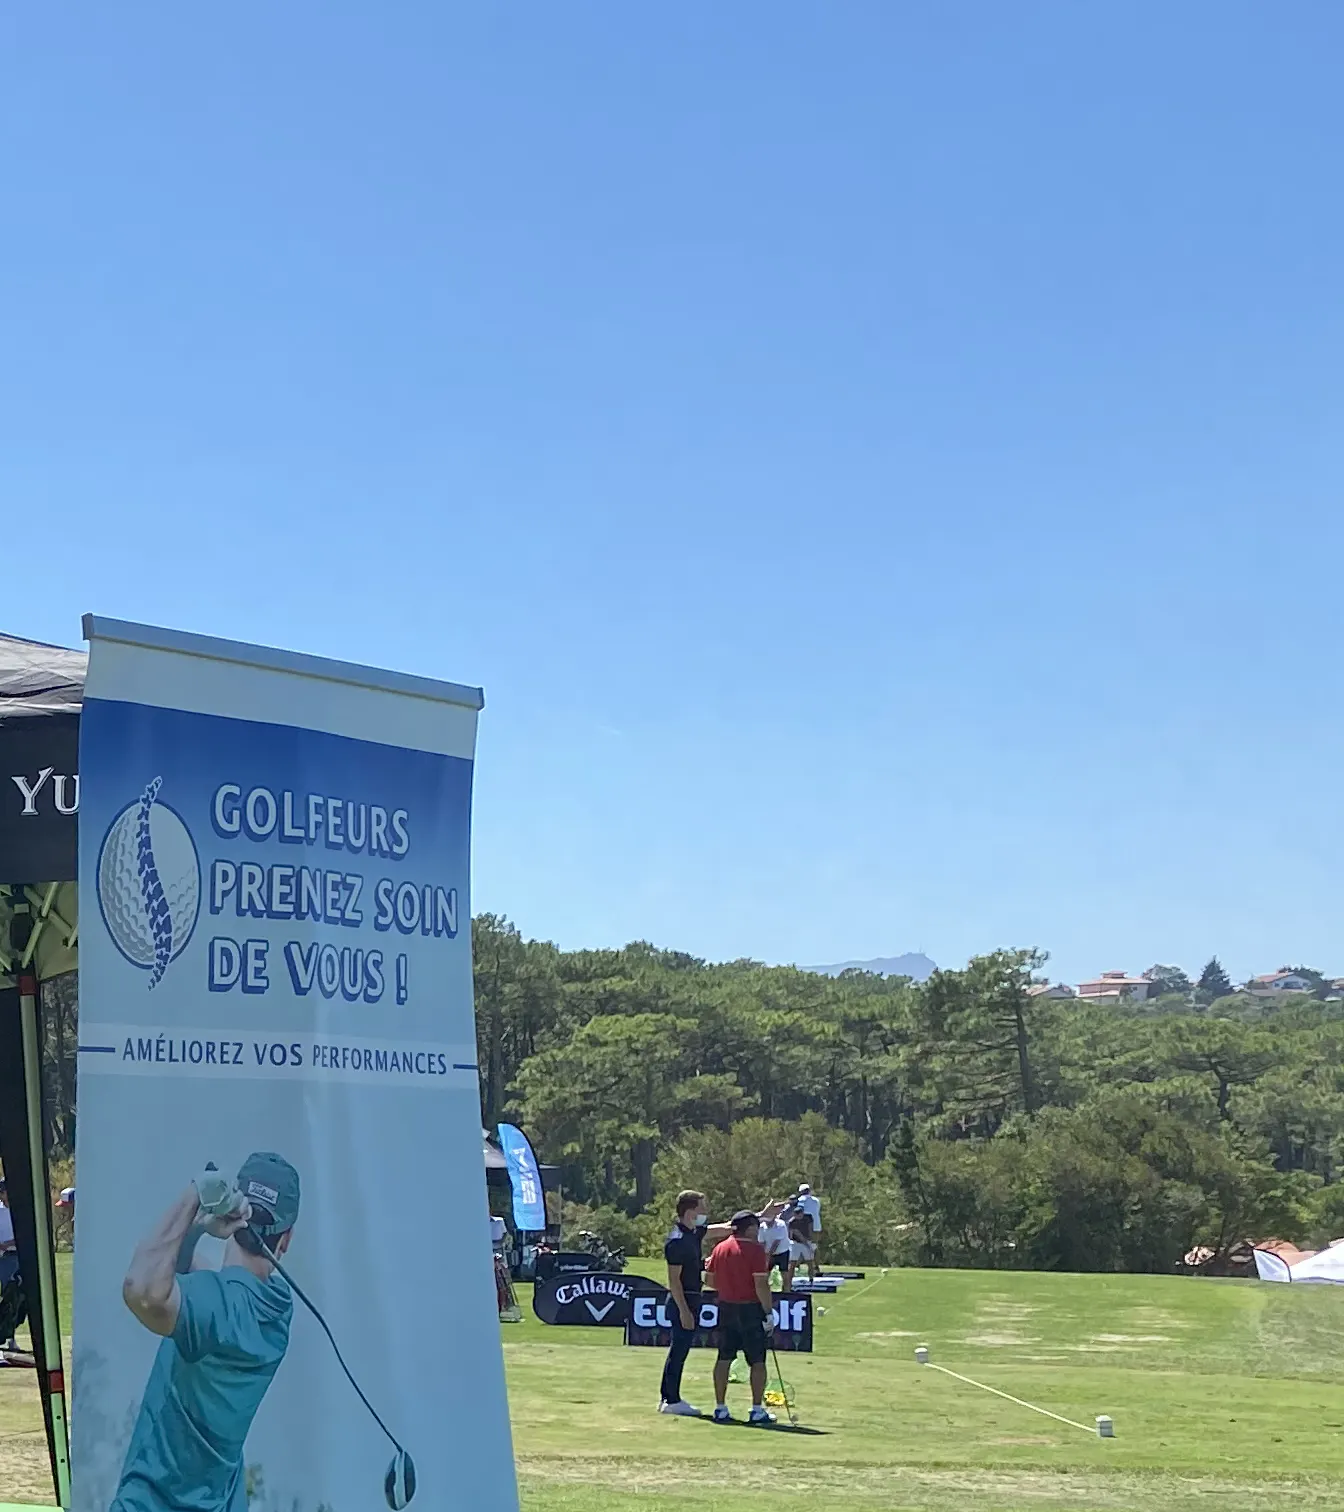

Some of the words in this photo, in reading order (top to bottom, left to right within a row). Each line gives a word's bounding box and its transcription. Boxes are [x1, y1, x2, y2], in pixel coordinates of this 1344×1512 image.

[212, 783, 411, 858] GOLFEURS
[209, 859, 364, 928] PRENEZ
[374, 877, 459, 939] SOIN
[208, 936, 270, 995] DE
[284, 941, 386, 1001] VOUS
[122, 1033, 245, 1066] AMÉLIOREZ
[254, 1042, 304, 1068] VOS
[312, 1045, 448, 1076] PERFORMANCES
[555, 1276, 633, 1304] Callawa
